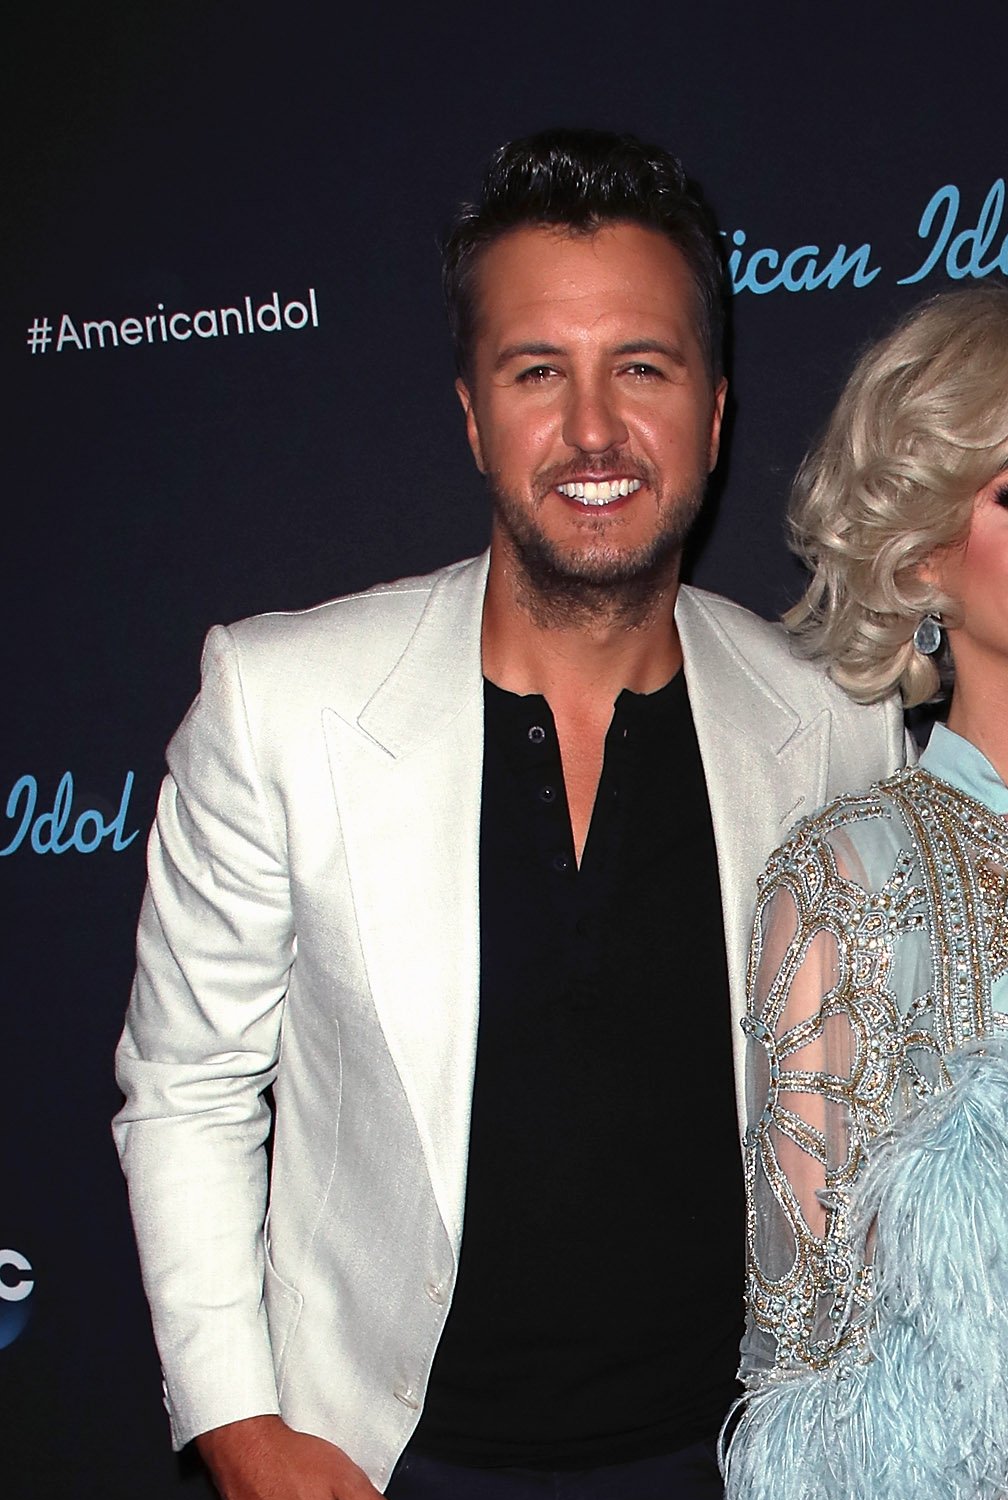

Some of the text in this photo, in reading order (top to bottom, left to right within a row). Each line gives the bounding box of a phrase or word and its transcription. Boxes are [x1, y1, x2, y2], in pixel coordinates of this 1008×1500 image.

[719, 228, 883, 296] ican
[26, 288, 319, 355] #AmericanIdol
[0, 770, 140, 857] Idol
